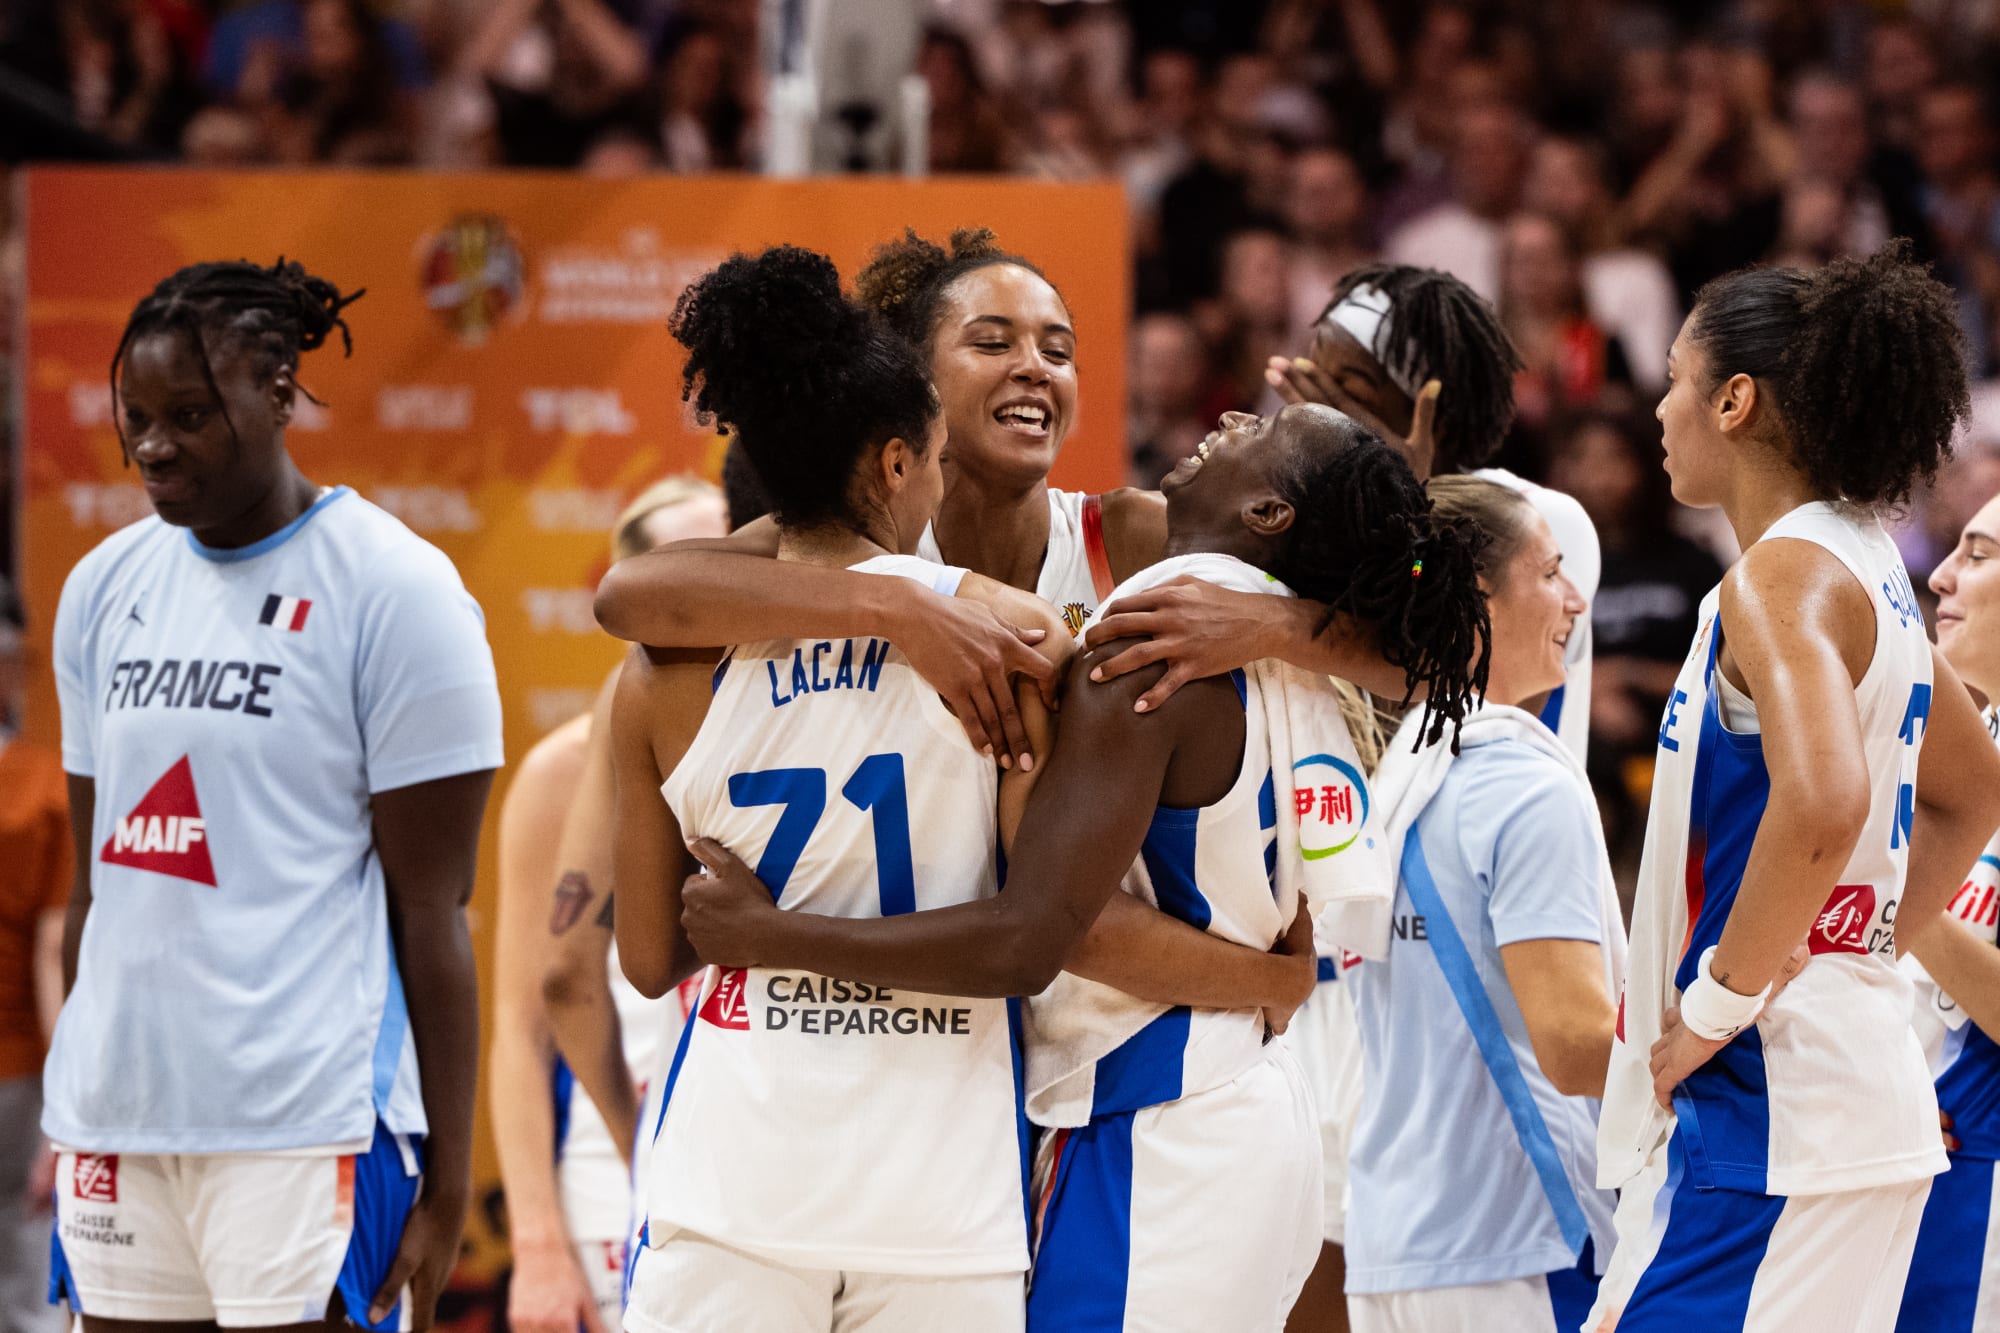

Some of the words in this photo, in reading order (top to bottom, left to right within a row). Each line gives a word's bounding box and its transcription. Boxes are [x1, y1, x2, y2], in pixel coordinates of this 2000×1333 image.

[106, 660, 282, 718] FRANCE
[767, 638, 890, 708] LACAN
[113, 815, 206, 854] MAIF
[728, 752, 916, 917] 71
[766, 976, 893, 1004] CAISSE
[766, 1006, 972, 1036] D'EPARGNE
